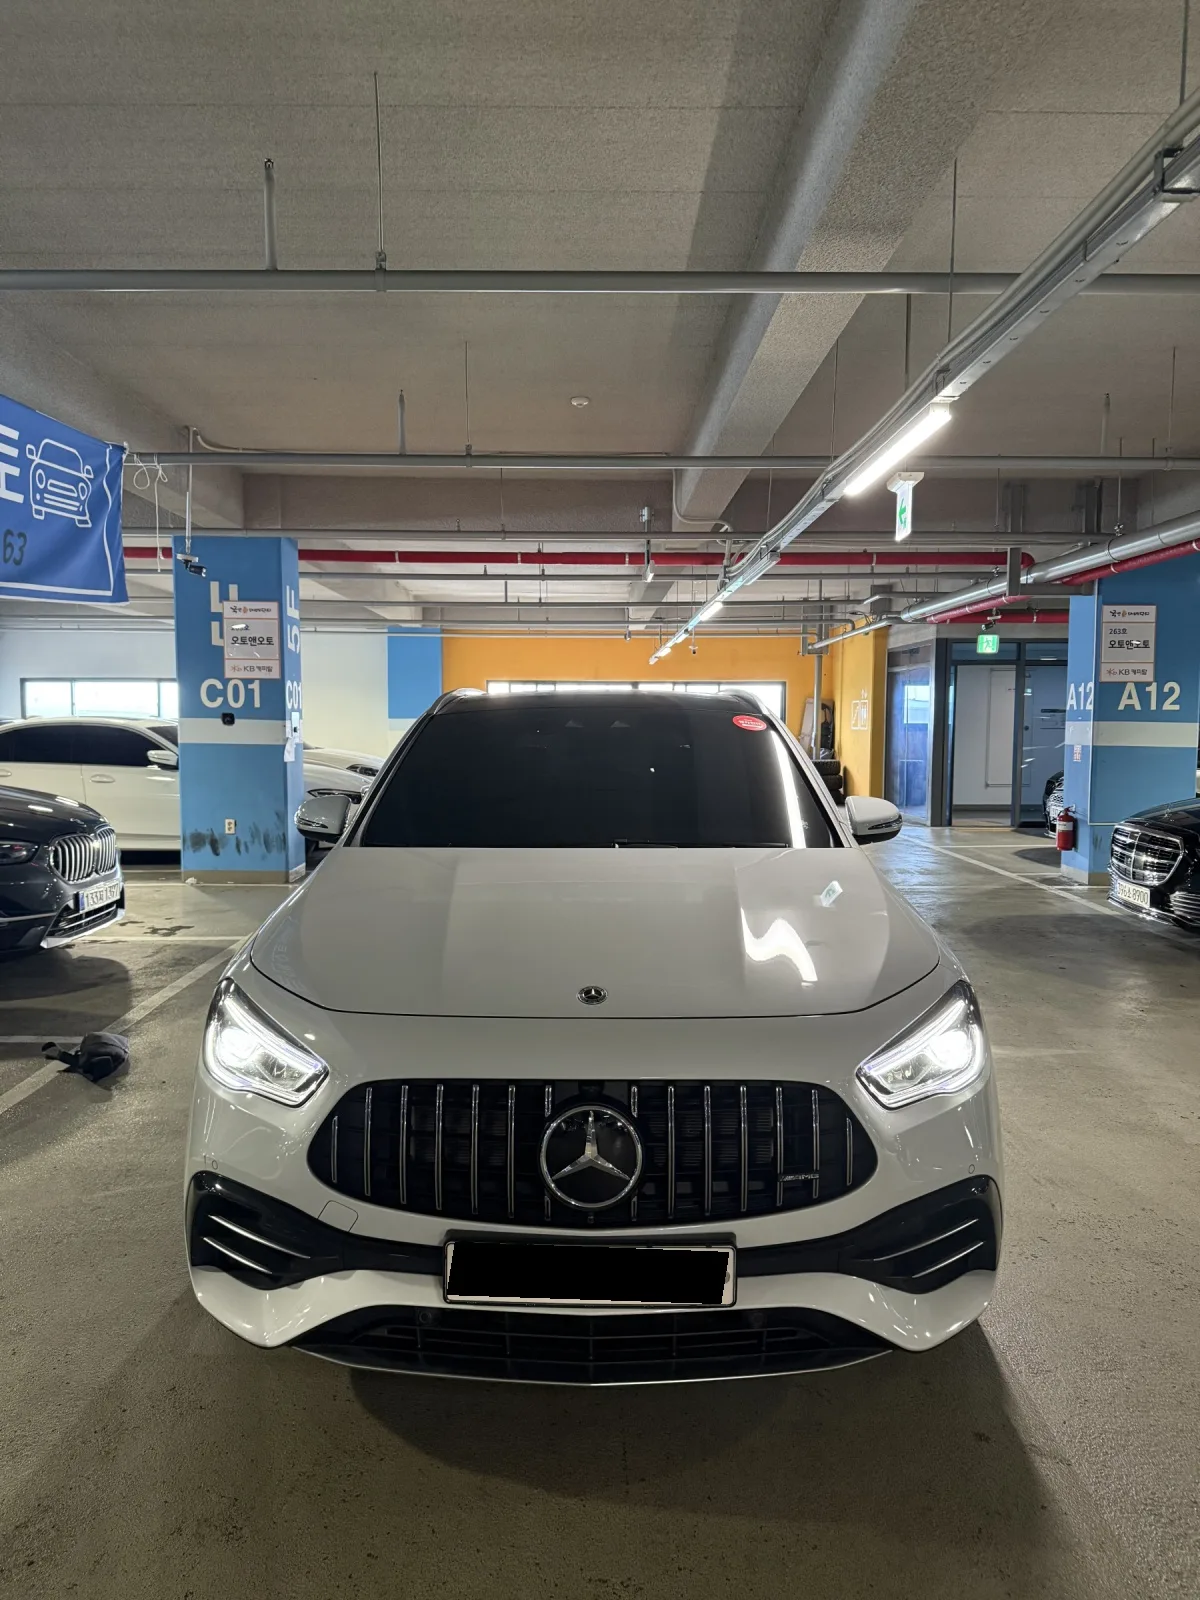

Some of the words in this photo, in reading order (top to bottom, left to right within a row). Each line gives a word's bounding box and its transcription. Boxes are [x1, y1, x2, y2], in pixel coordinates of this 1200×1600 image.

[230, 636, 275, 647] 오토앤오토
[200, 678, 261, 709] C01
[1066, 681, 1094, 711] A12
[1117, 681, 1181, 711] A12
